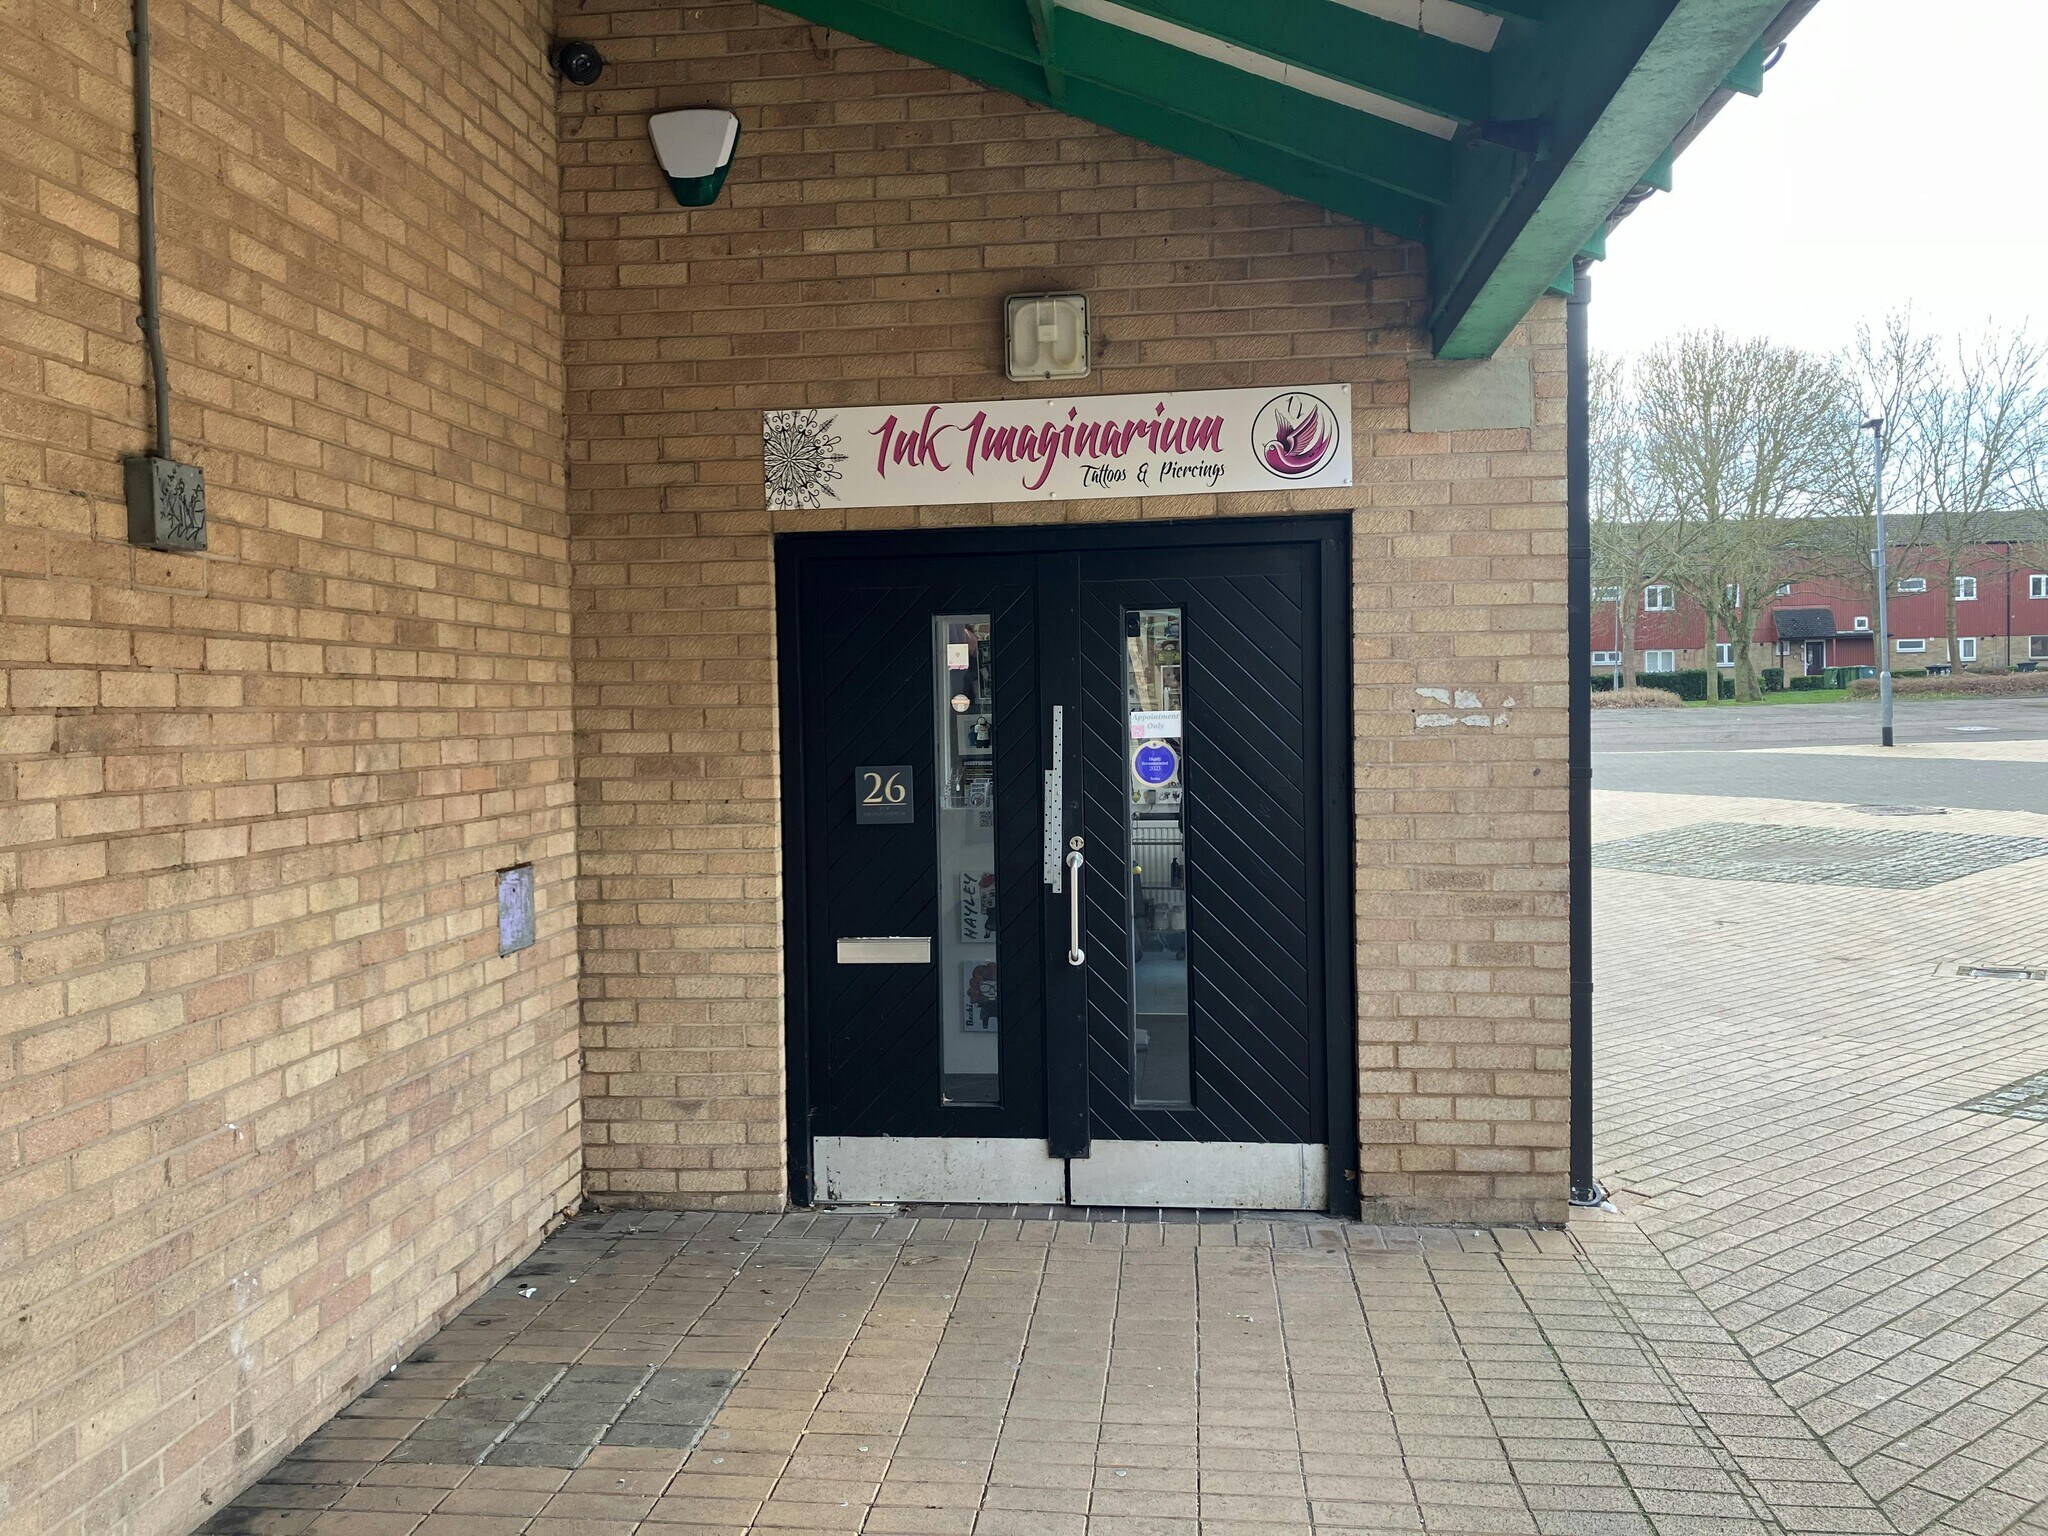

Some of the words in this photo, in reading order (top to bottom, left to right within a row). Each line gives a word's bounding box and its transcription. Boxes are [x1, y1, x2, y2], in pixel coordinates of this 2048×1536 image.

[868, 405, 957, 480] Ink
[956, 402, 1225, 490] Imaginarium
[1080, 464, 1128, 489] Tattoos
[1137, 462, 1149, 488] &
[1159, 460, 1225, 488] Piercings
[1132, 713, 1179, 721] Appointment
[1147, 722, 1165, 730] Only
[863, 772, 906, 803] 26
[963, 873, 978, 939] HAYLEY
